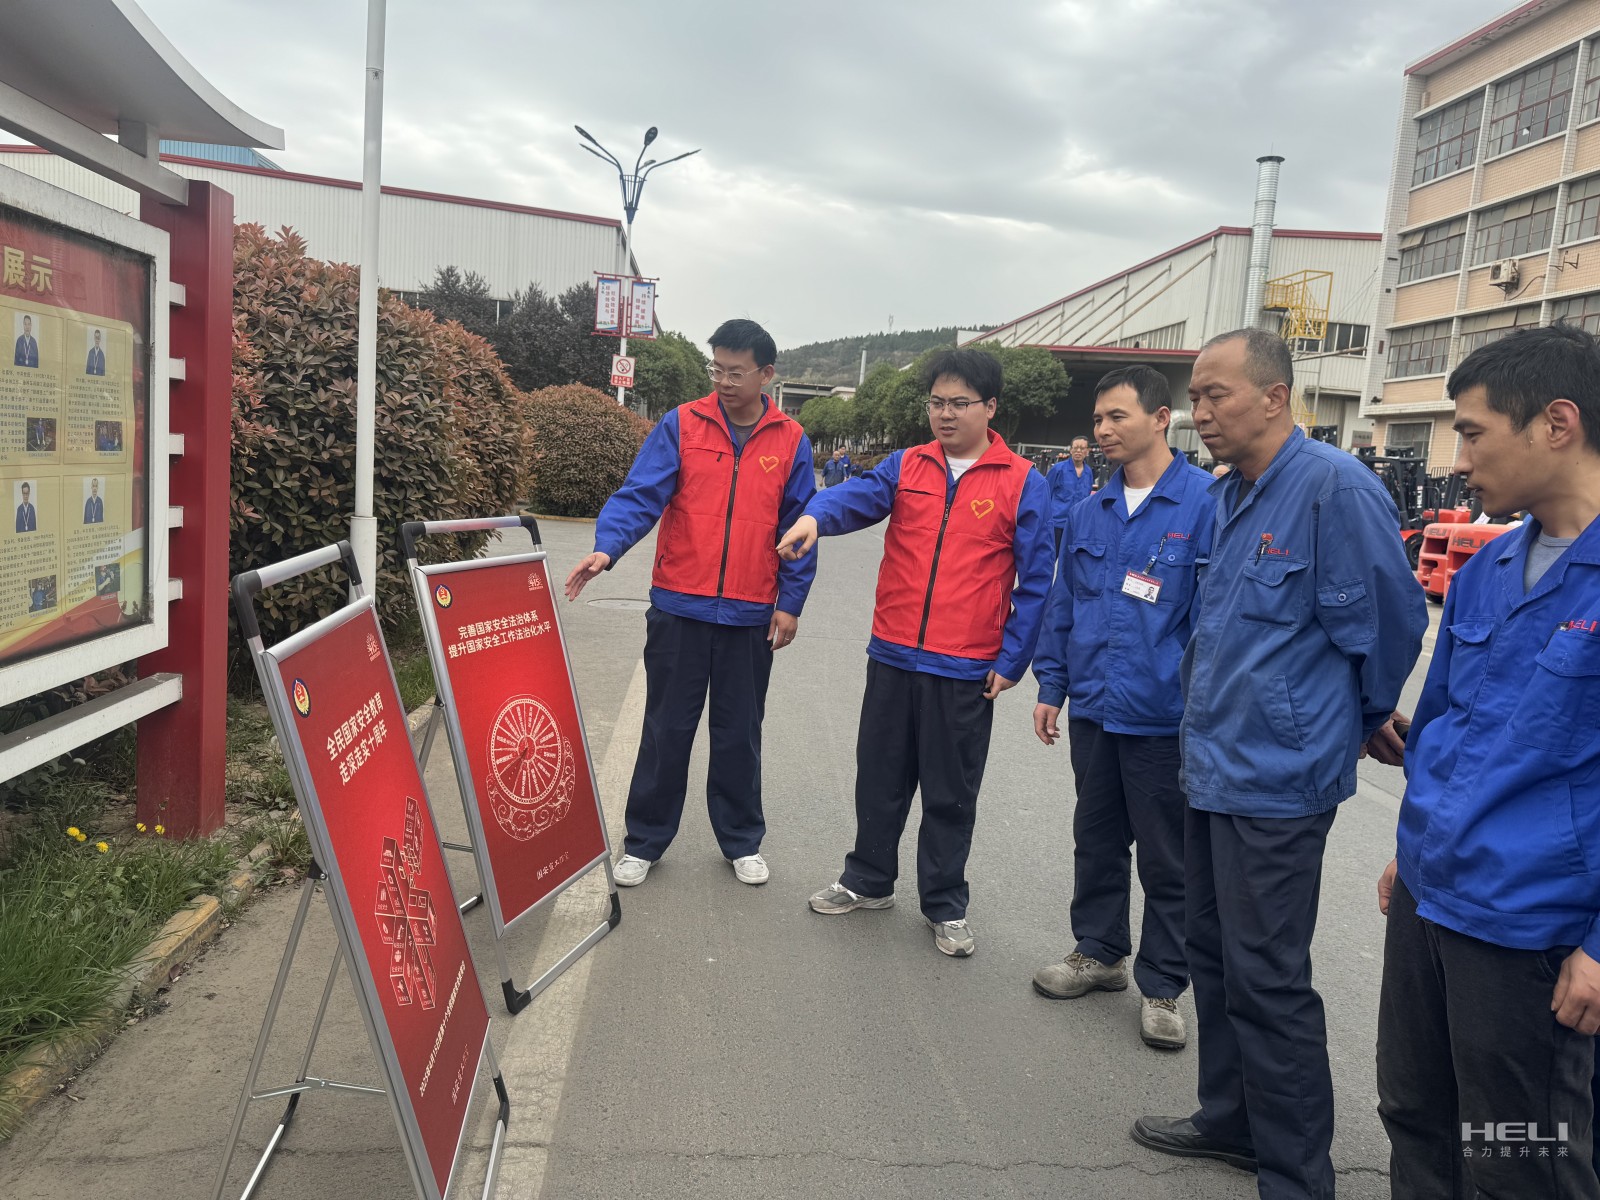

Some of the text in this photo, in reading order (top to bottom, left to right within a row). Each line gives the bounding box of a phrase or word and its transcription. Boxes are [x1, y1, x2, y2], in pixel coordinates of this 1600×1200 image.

[3, 245, 53, 292] 展示
[1426, 528, 1447, 536] HELI
[448, 621, 552, 658] 提升国家安全工作法治化水平
[458, 610, 539, 639] 完善国家安全法治体系
[326, 692, 384, 761] 全民国家安全教育
[338, 719, 388, 786] 走深走实十周年
